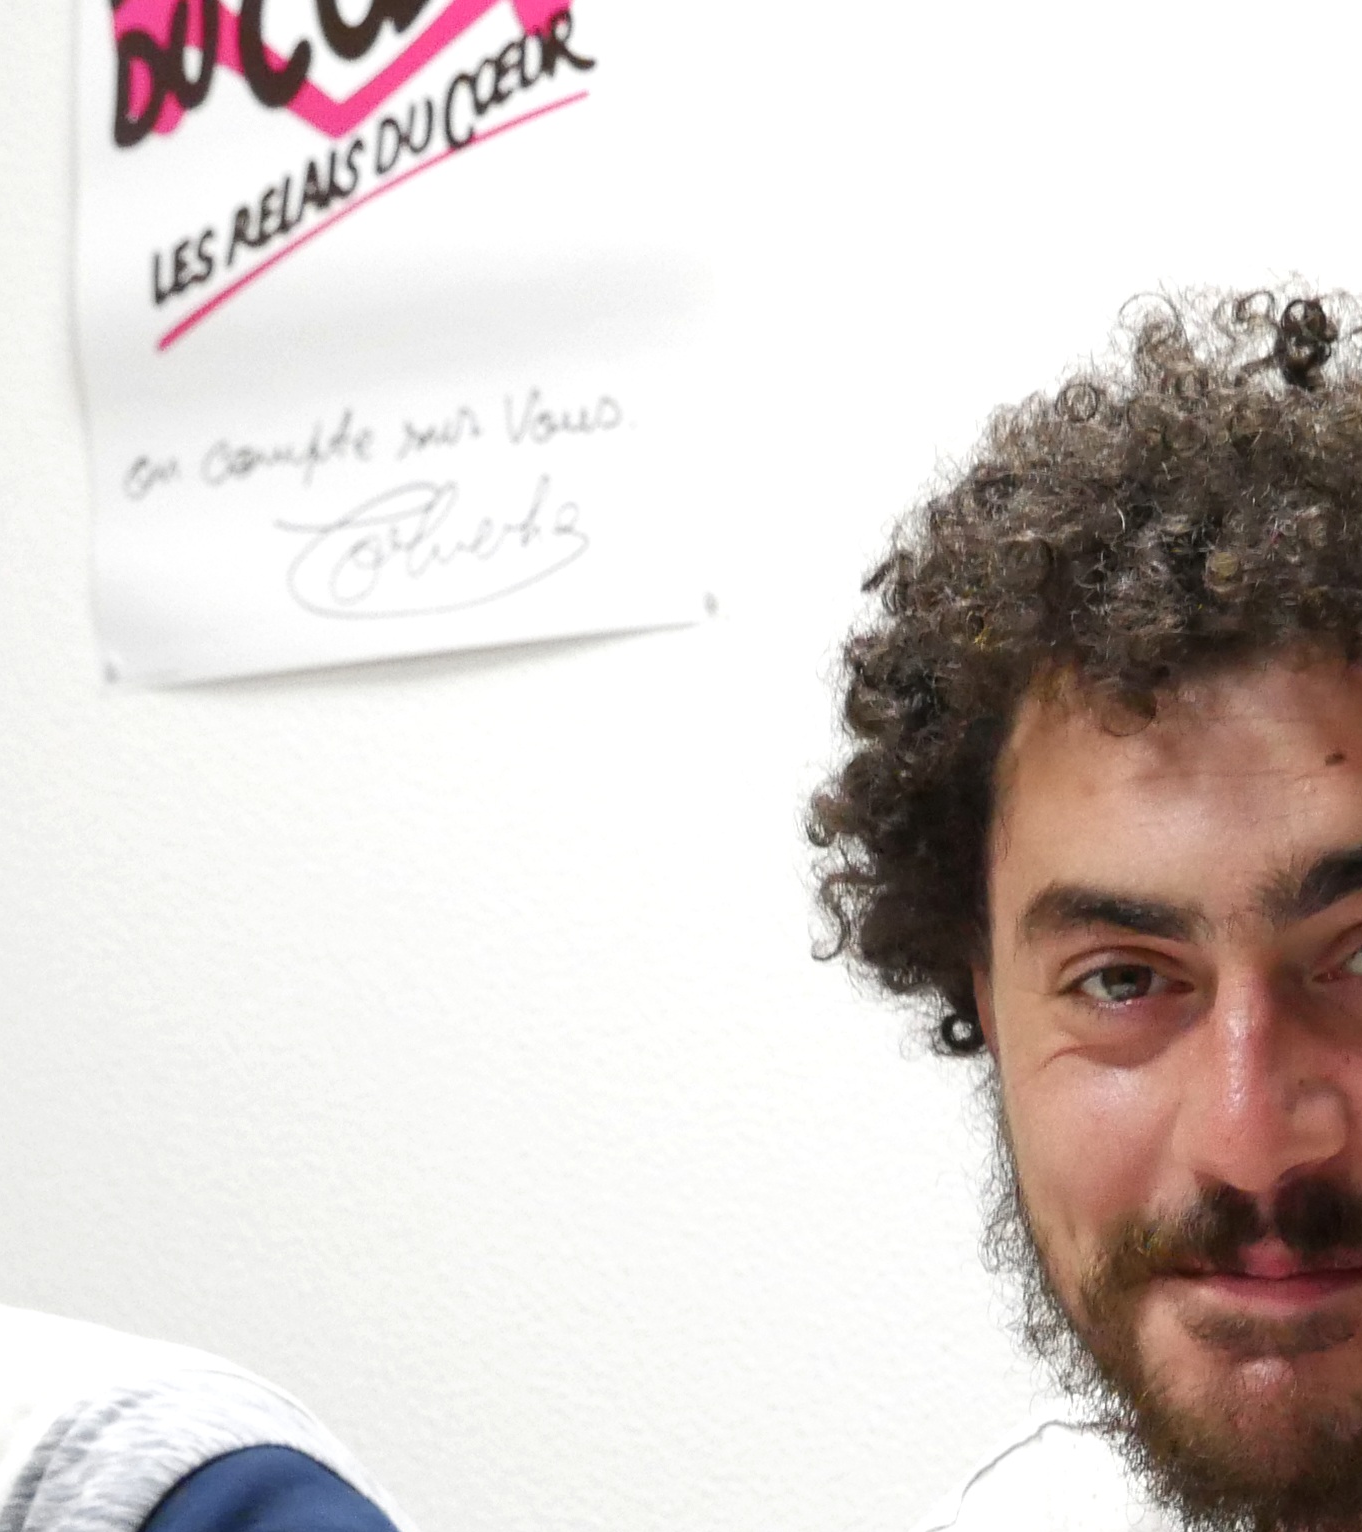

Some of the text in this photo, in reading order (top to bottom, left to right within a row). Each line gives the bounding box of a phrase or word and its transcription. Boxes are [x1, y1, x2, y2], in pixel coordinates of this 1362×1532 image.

[151, 228, 216, 305] LES
[224, 137, 366, 268] RELAIS
[375, 99, 433, 176] DU
